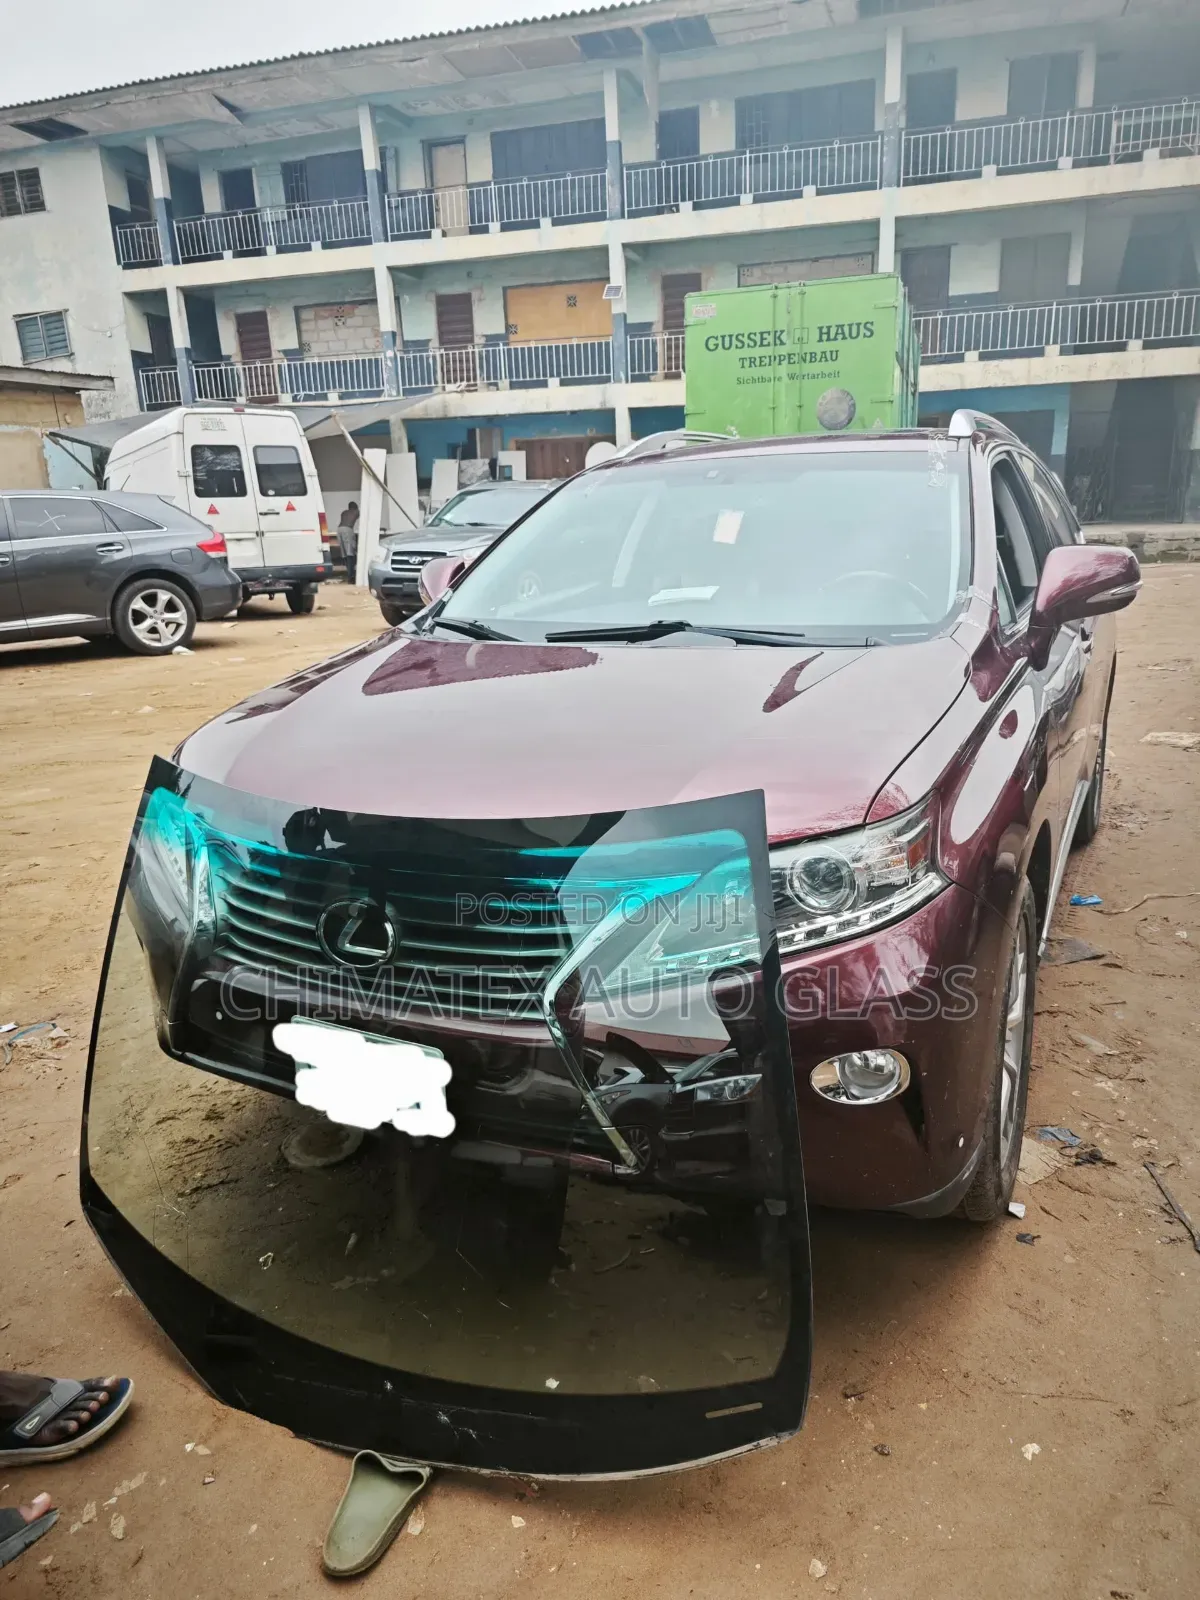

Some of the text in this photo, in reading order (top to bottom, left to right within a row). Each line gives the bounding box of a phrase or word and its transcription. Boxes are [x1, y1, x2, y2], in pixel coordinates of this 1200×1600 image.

[705, 321, 875, 352] GUSSEK HAUS
[739, 350, 840, 369] TREPPENBAU
[736, 375, 782, 385] Sichtbare
